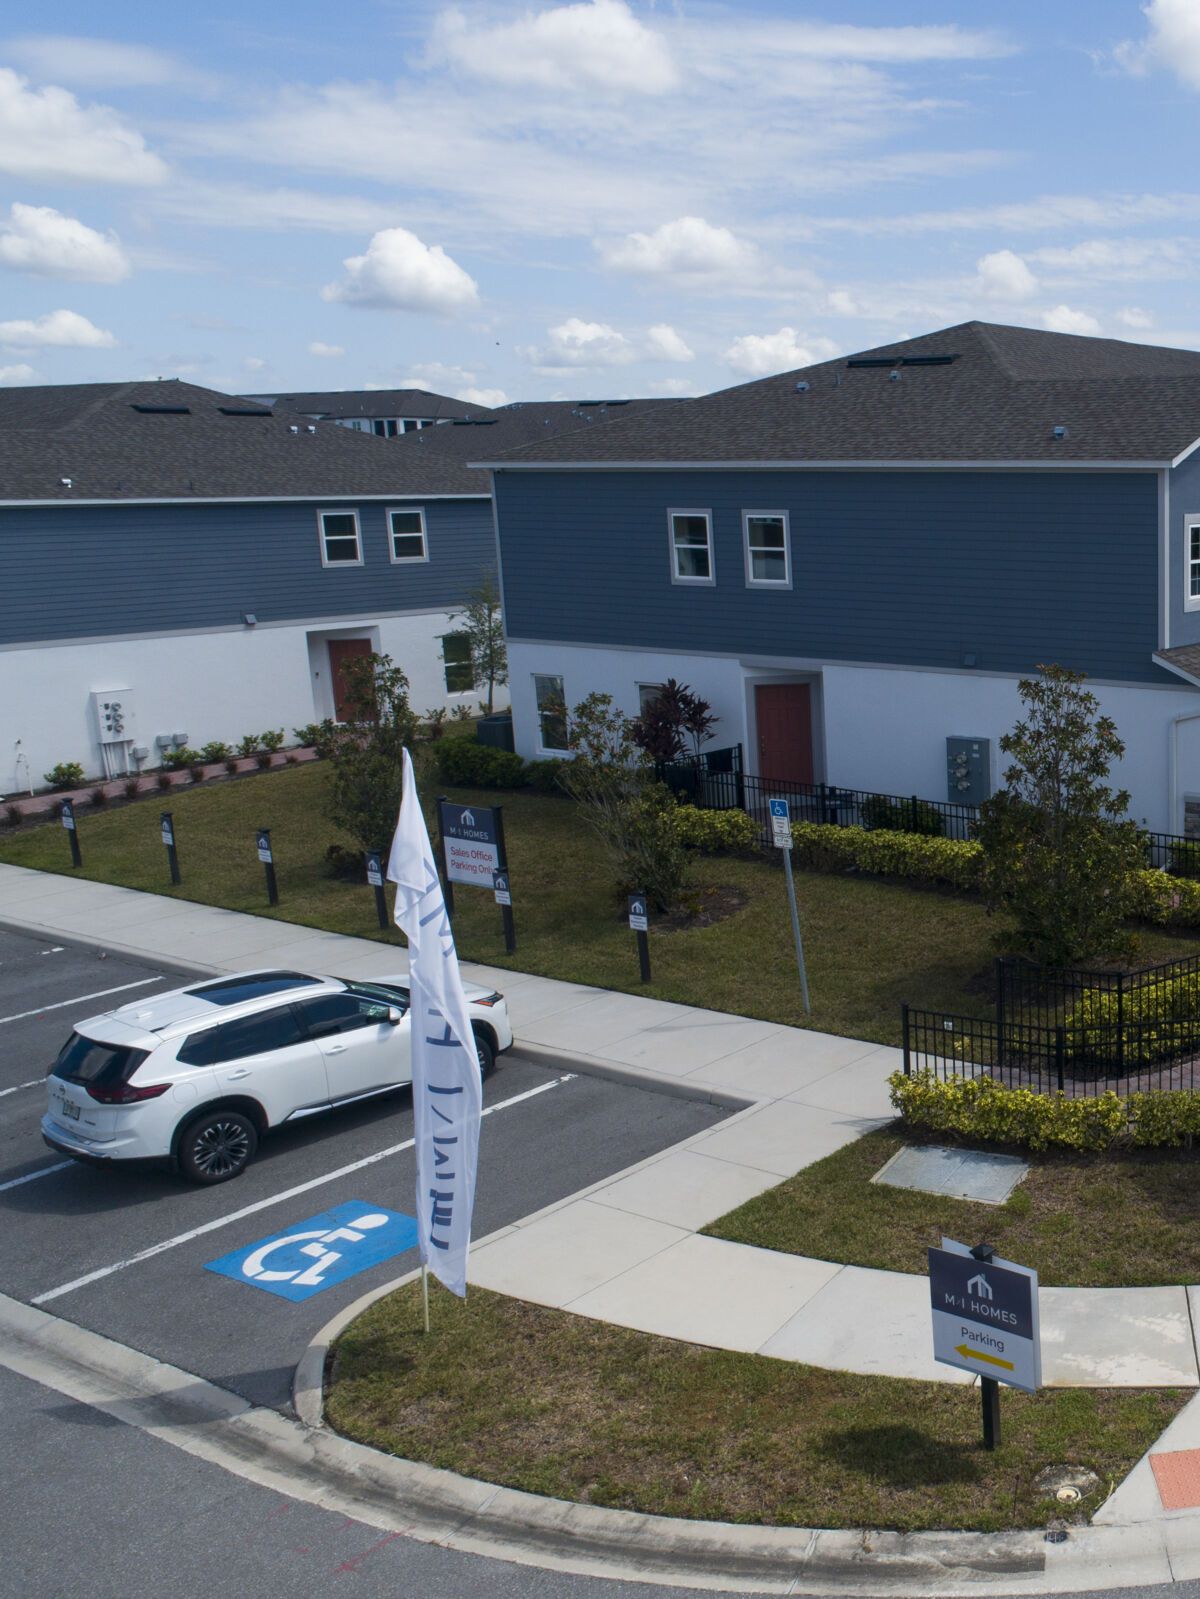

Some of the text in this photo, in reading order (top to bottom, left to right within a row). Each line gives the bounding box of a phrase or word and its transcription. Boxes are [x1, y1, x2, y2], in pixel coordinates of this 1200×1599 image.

[463, 829, 489, 840] HOMES
[450, 846, 493, 862] Sales Office
[451, 860, 477, 874] Parking
[971, 1301, 1018, 1325] HOMES
[960, 1326, 1005, 1352] Parking
